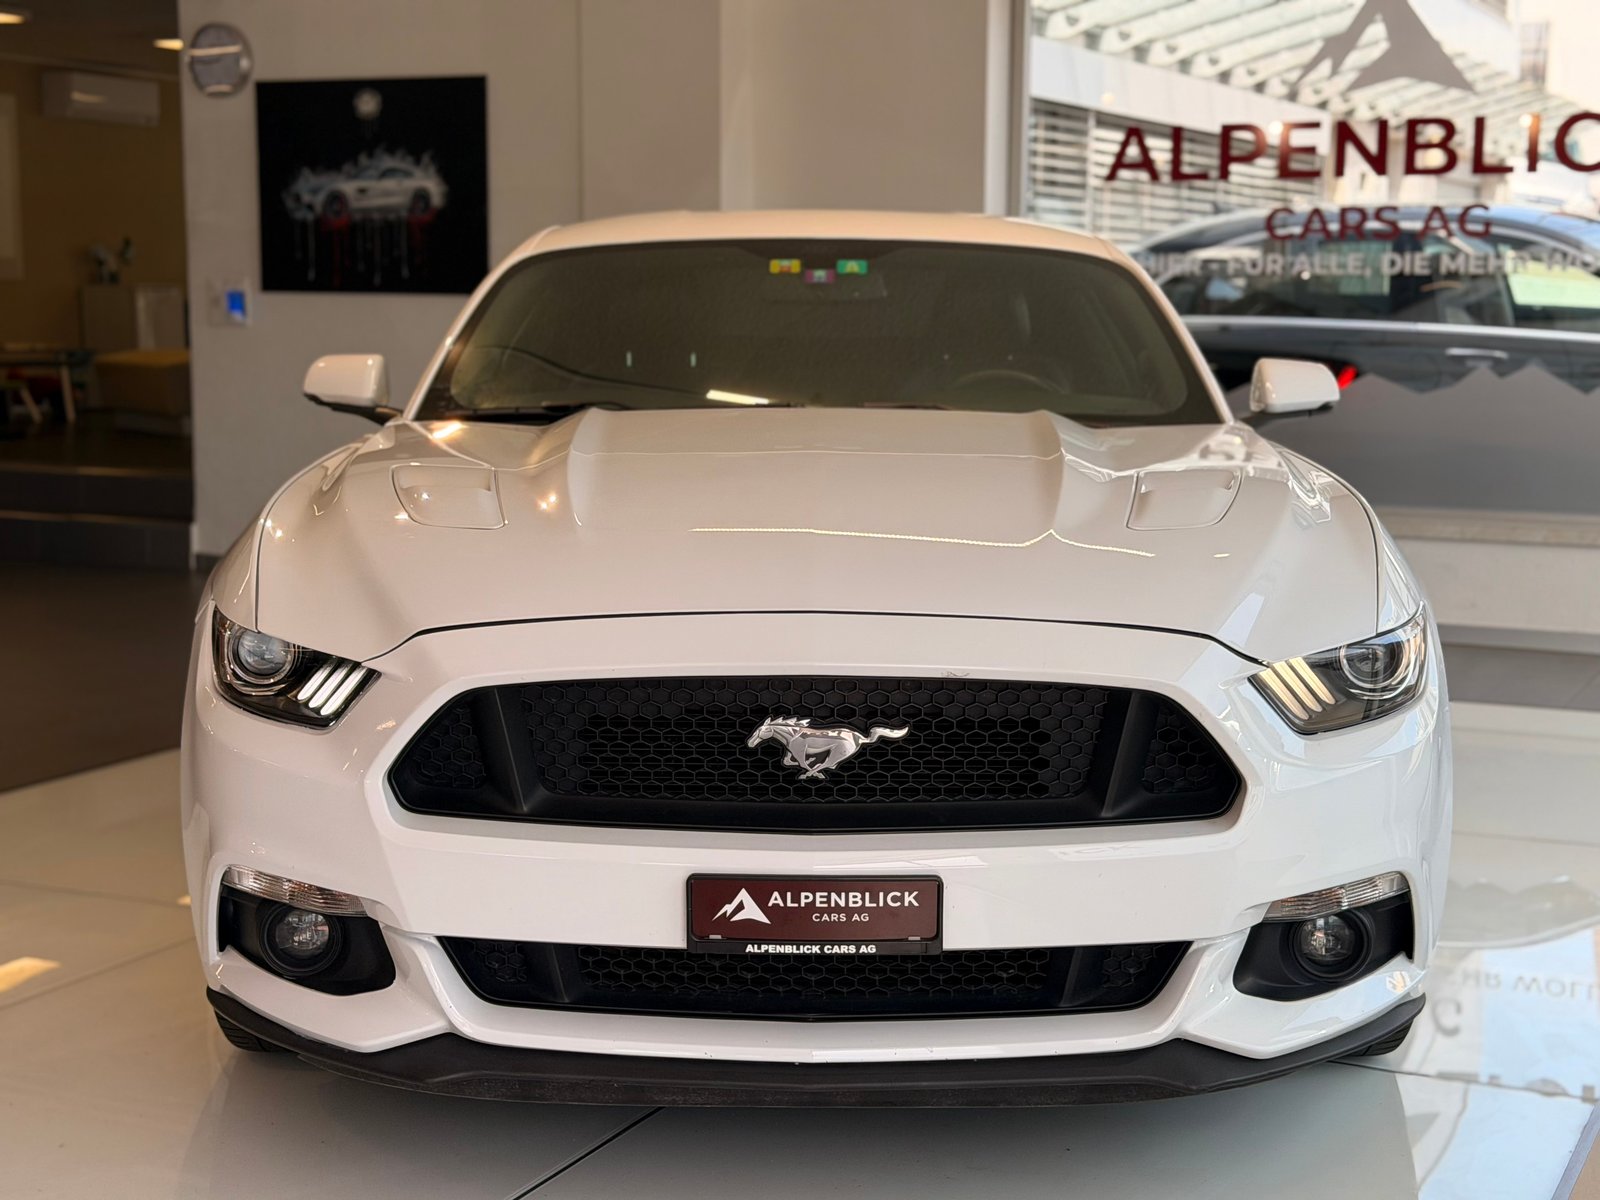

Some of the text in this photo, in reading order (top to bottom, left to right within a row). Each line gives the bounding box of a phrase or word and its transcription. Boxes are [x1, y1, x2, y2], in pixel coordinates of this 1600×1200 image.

[1265, 204, 1493, 241] CARS AG
[1292, 252, 1371, 278] ALLE,
[1382, 252, 1432, 276] DIE
[768, 890, 920, 908] ALPENBLICK
[812, 913, 870, 922] CARS AG
[745, 943, 876, 954] ALPENBLICK CARS AG
